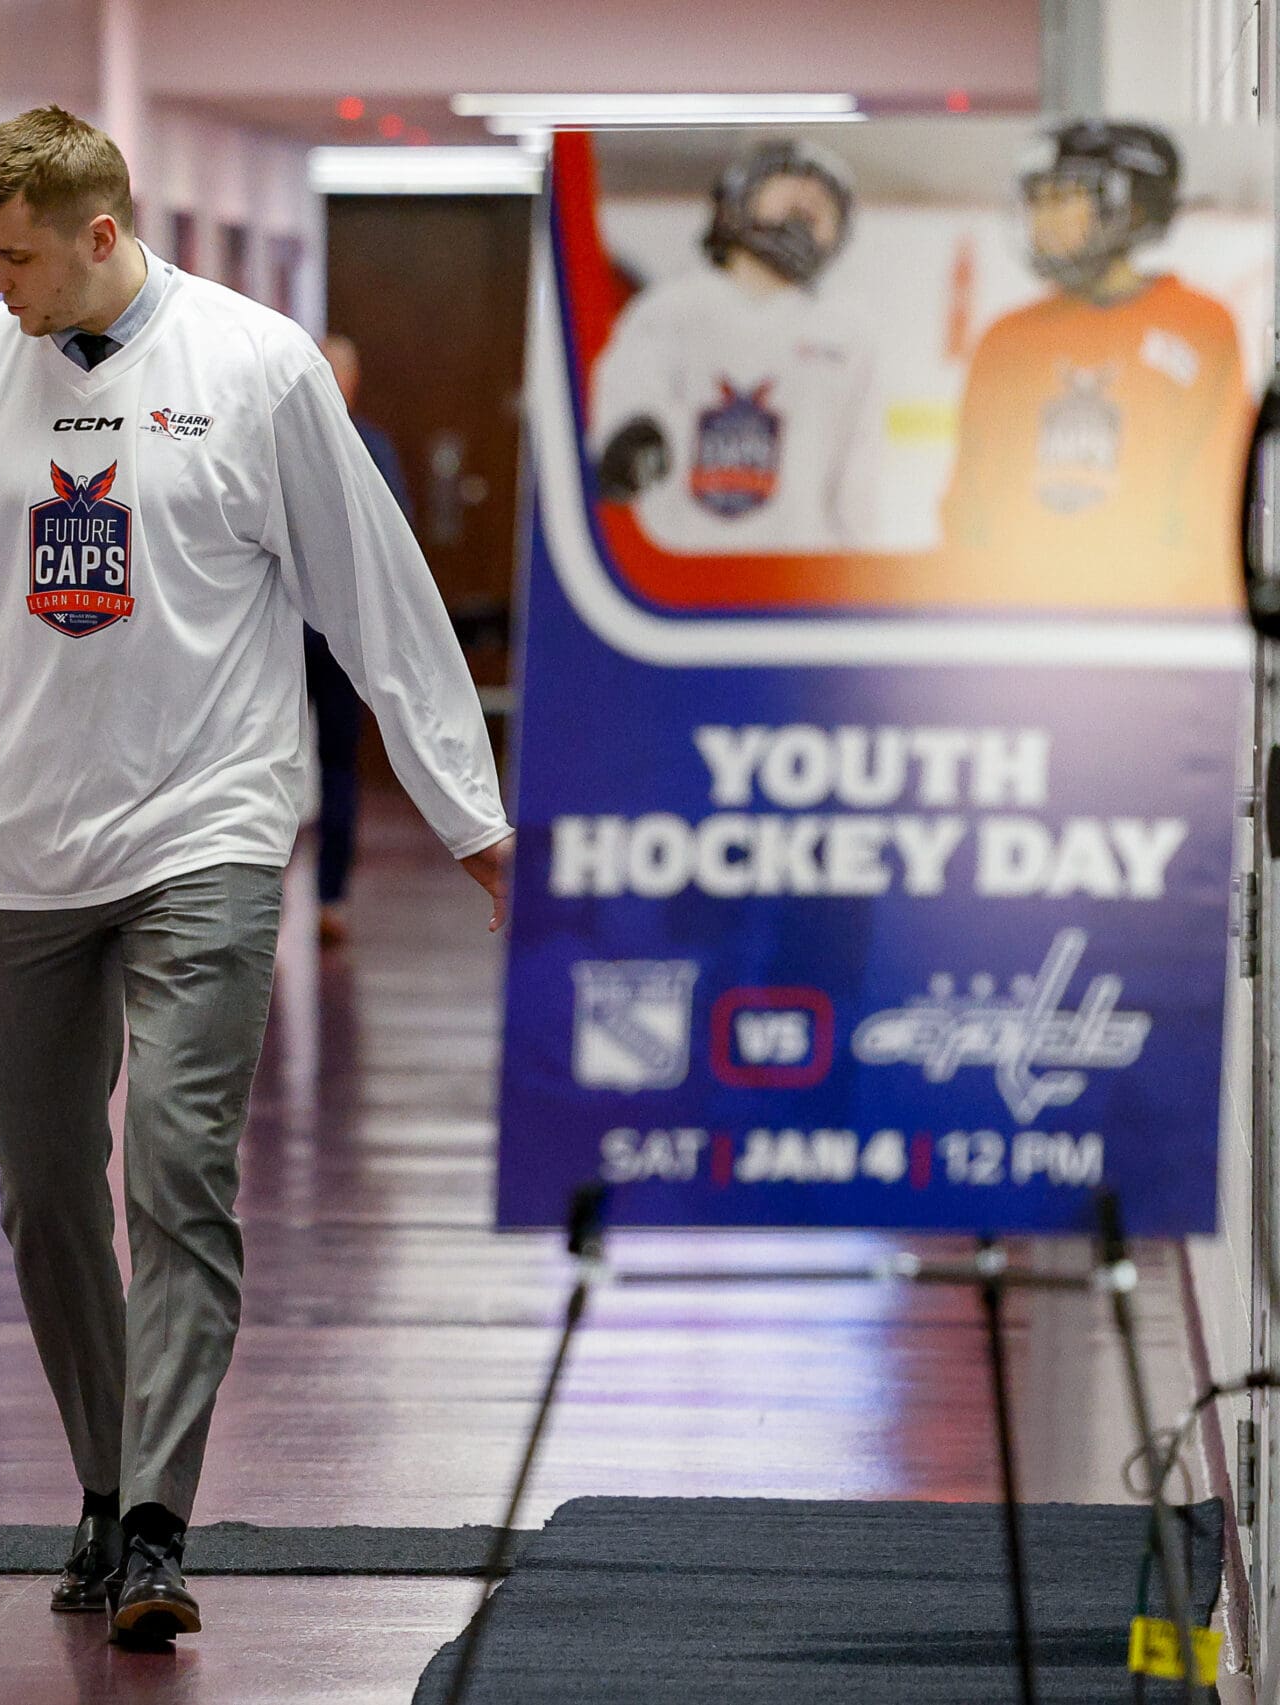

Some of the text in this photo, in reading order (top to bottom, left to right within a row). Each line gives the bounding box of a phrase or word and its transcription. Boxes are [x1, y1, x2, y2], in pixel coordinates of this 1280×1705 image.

[53, 417, 124, 432] CCM
[170, 414, 210, 427] LEARN
[174, 425, 207, 437] PLAY
[45, 518, 118, 544] FUTURE
[35, 544, 125, 586] CAPS
[29, 594, 130, 612] LEARN TO PLAY
[694, 723, 1054, 807] YOUTH
[548, 812, 1189, 900] HOCKEY DAY
[600, 1127, 1106, 1187] SAT JAN 4 12 PM
